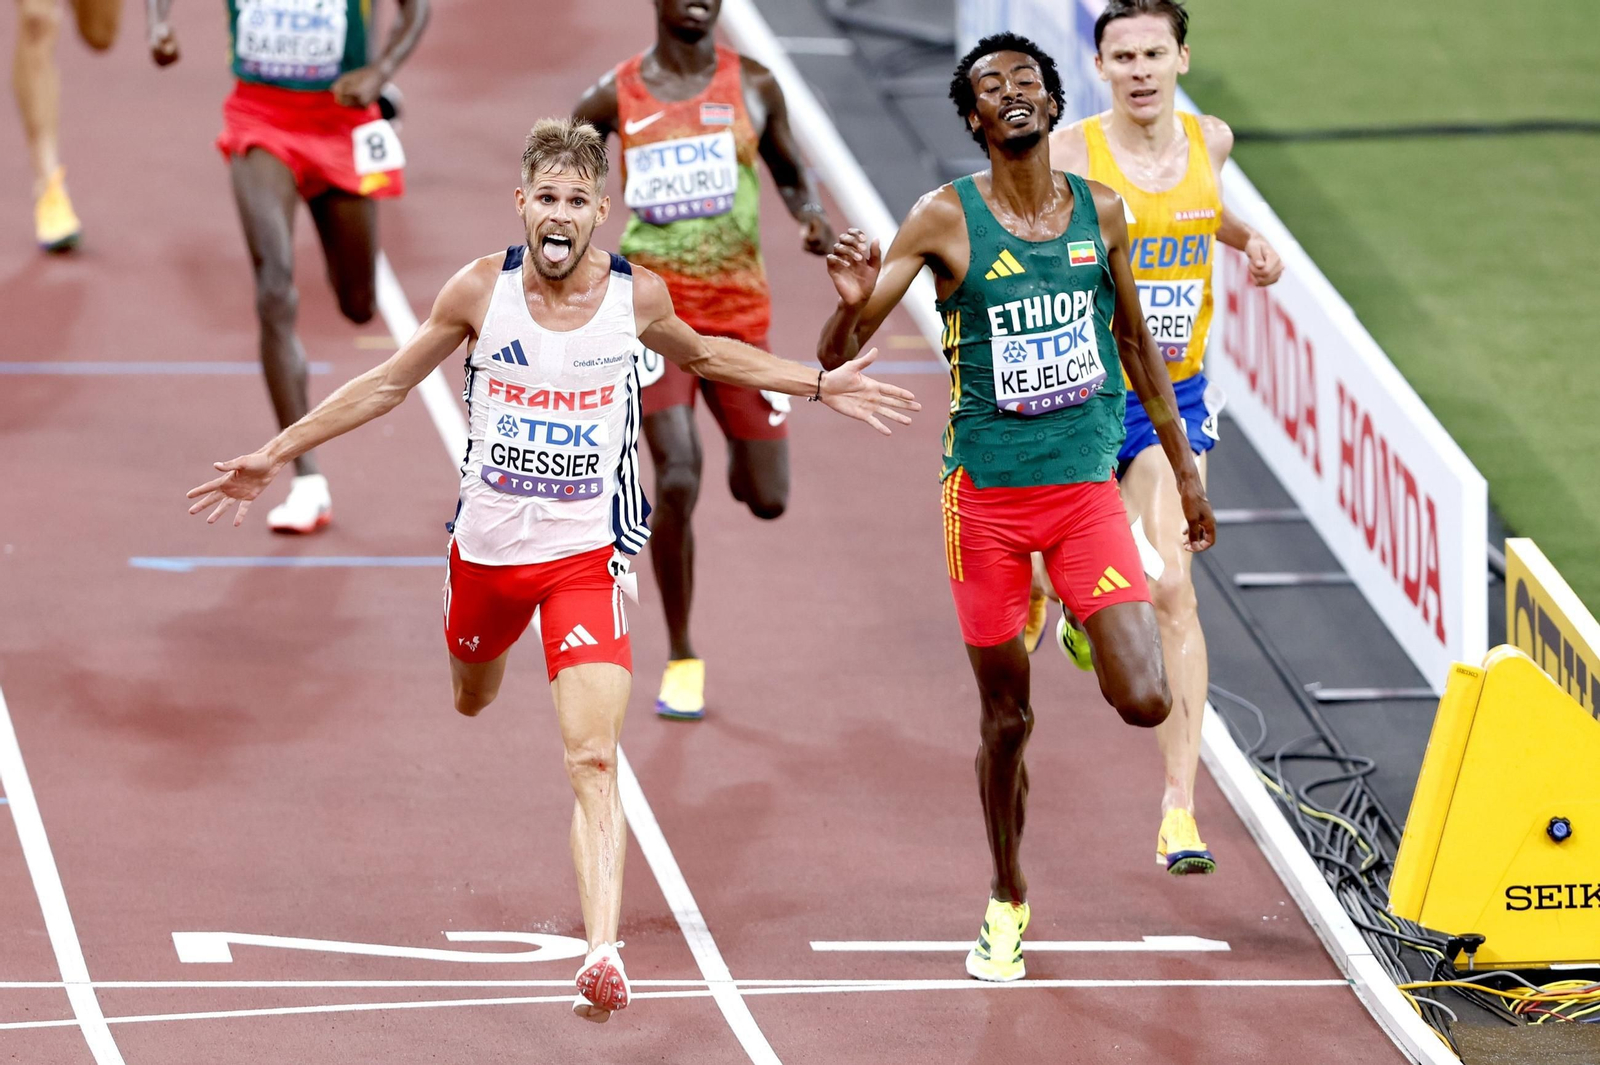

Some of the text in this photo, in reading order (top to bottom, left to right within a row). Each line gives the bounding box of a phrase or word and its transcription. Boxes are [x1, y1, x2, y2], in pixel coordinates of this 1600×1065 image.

[366, 132, 387, 161] 8
[652, 139, 723, 168] TDK
[1175, 209, 1215, 221] BAUHAUS
[1129, 234, 1211, 269] EDEN
[1136, 285, 1196, 308] TDK
[1026, 321, 1090, 360] TDK
[573, 359, 596, 368] Crédit
[1001, 349, 1099, 395] KEJELCHA
[1223, 243, 1323, 478] HONDA
[488, 378, 616, 412] FRANCE
[520, 417, 599, 447] TDK
[491, 442, 600, 477] GRESSIER
[1336, 377, 1446, 648] HONDA
[1455, 667, 1479, 678] SEIKO
[1505, 883, 1600, 911] SEIK
